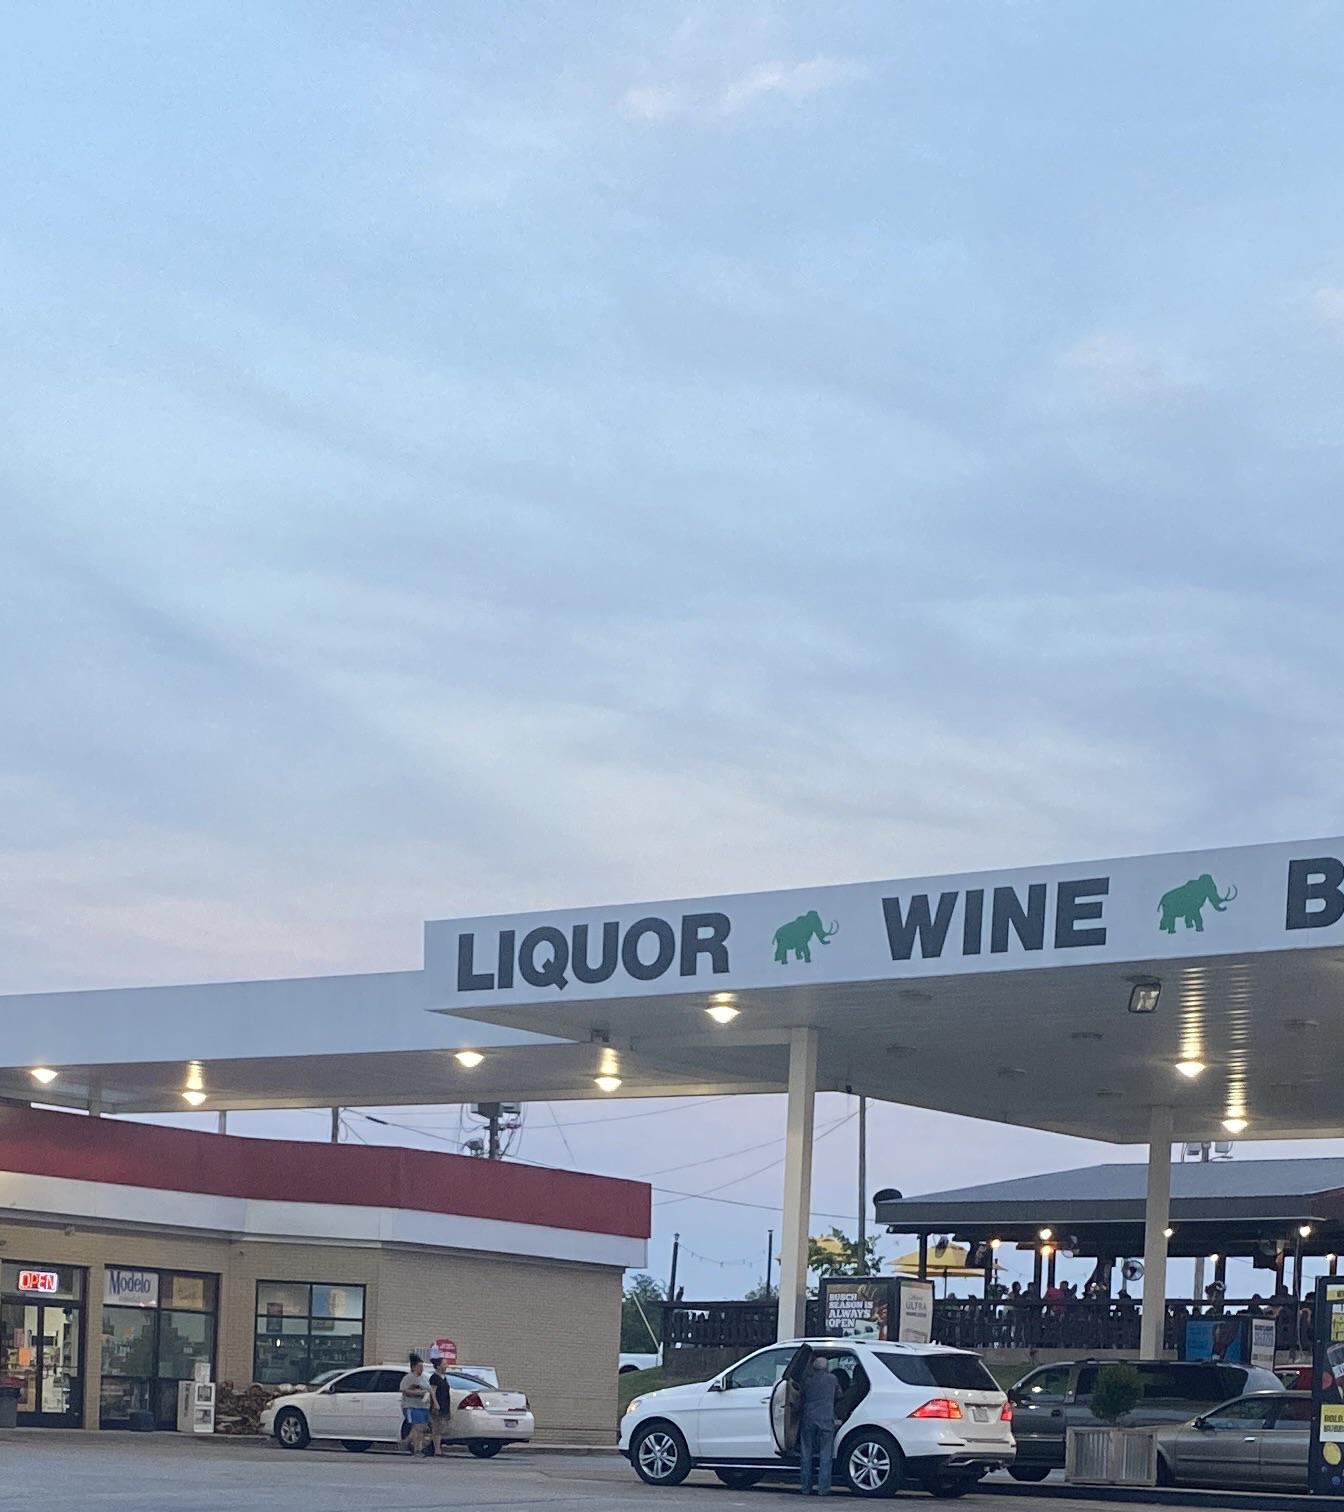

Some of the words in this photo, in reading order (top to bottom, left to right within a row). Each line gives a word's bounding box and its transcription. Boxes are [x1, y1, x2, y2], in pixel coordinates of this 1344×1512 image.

[457, 912, 731, 991] LIQUOR
[882, 877, 1110, 961] WINE
[21, 1272, 56, 1290] OPEN
[109, 1269, 151, 1295] Modelo
[864, 1301, 874, 1309] IS
[828, 1309, 872, 1318] ALWAYS
[828, 1318, 856, 1328] OPEN
